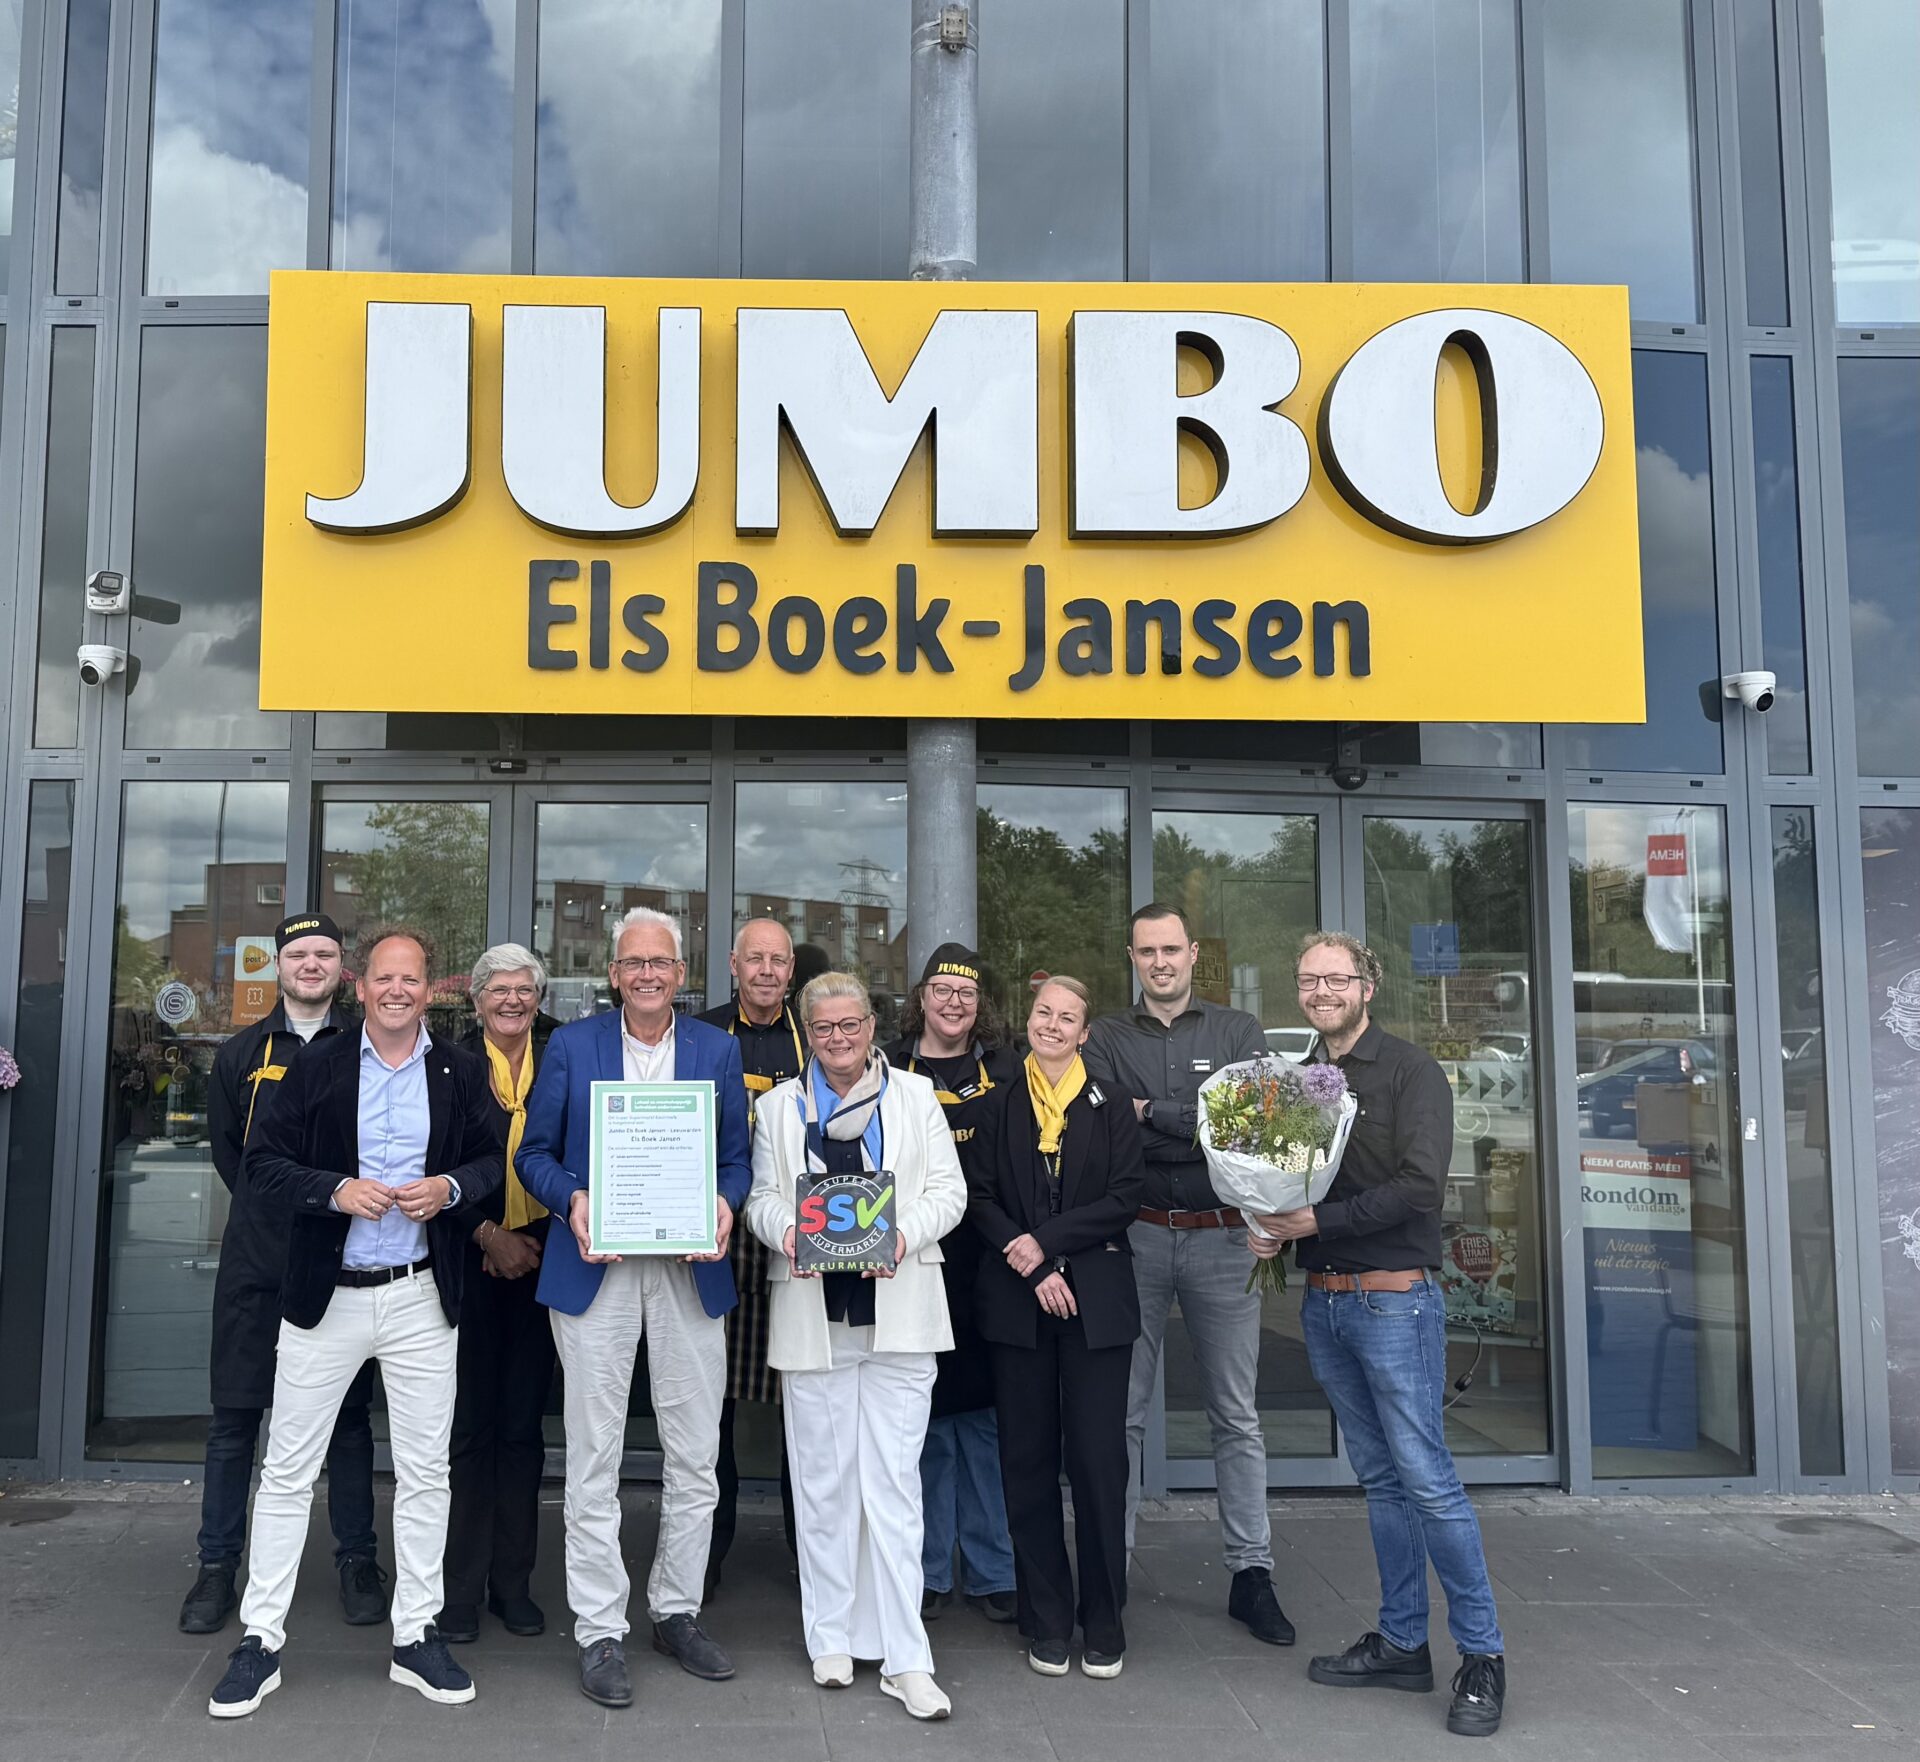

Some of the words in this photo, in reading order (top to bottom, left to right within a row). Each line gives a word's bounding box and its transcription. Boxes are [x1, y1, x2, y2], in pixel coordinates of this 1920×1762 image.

[305, 301, 1605, 544] JUMBO
[528, 559, 669, 672] Els
[697, 560, 1371, 692] Boek-Jansen
[284, 920, 320, 935] JUMBO
[937, 962, 979, 980] JUMBO
[1583, 1157, 1613, 1168] NEEM
[1616, 1160, 1653, 1170] GRATIS
[823, 1176, 868, 1188] SUPER
[1581, 1185, 1680, 1205] RondOm
[811, 1231, 881, 1255] SUPERMARKT
[1460, 1235, 1489, 1249] FRIES
[1605, 1238, 1658, 1253] Nieuws
[1462, 1247, 1490, 1258] STRAAT
[810, 1261, 884, 1271] KEURMERK
[1615, 1255, 1633, 1268] de
